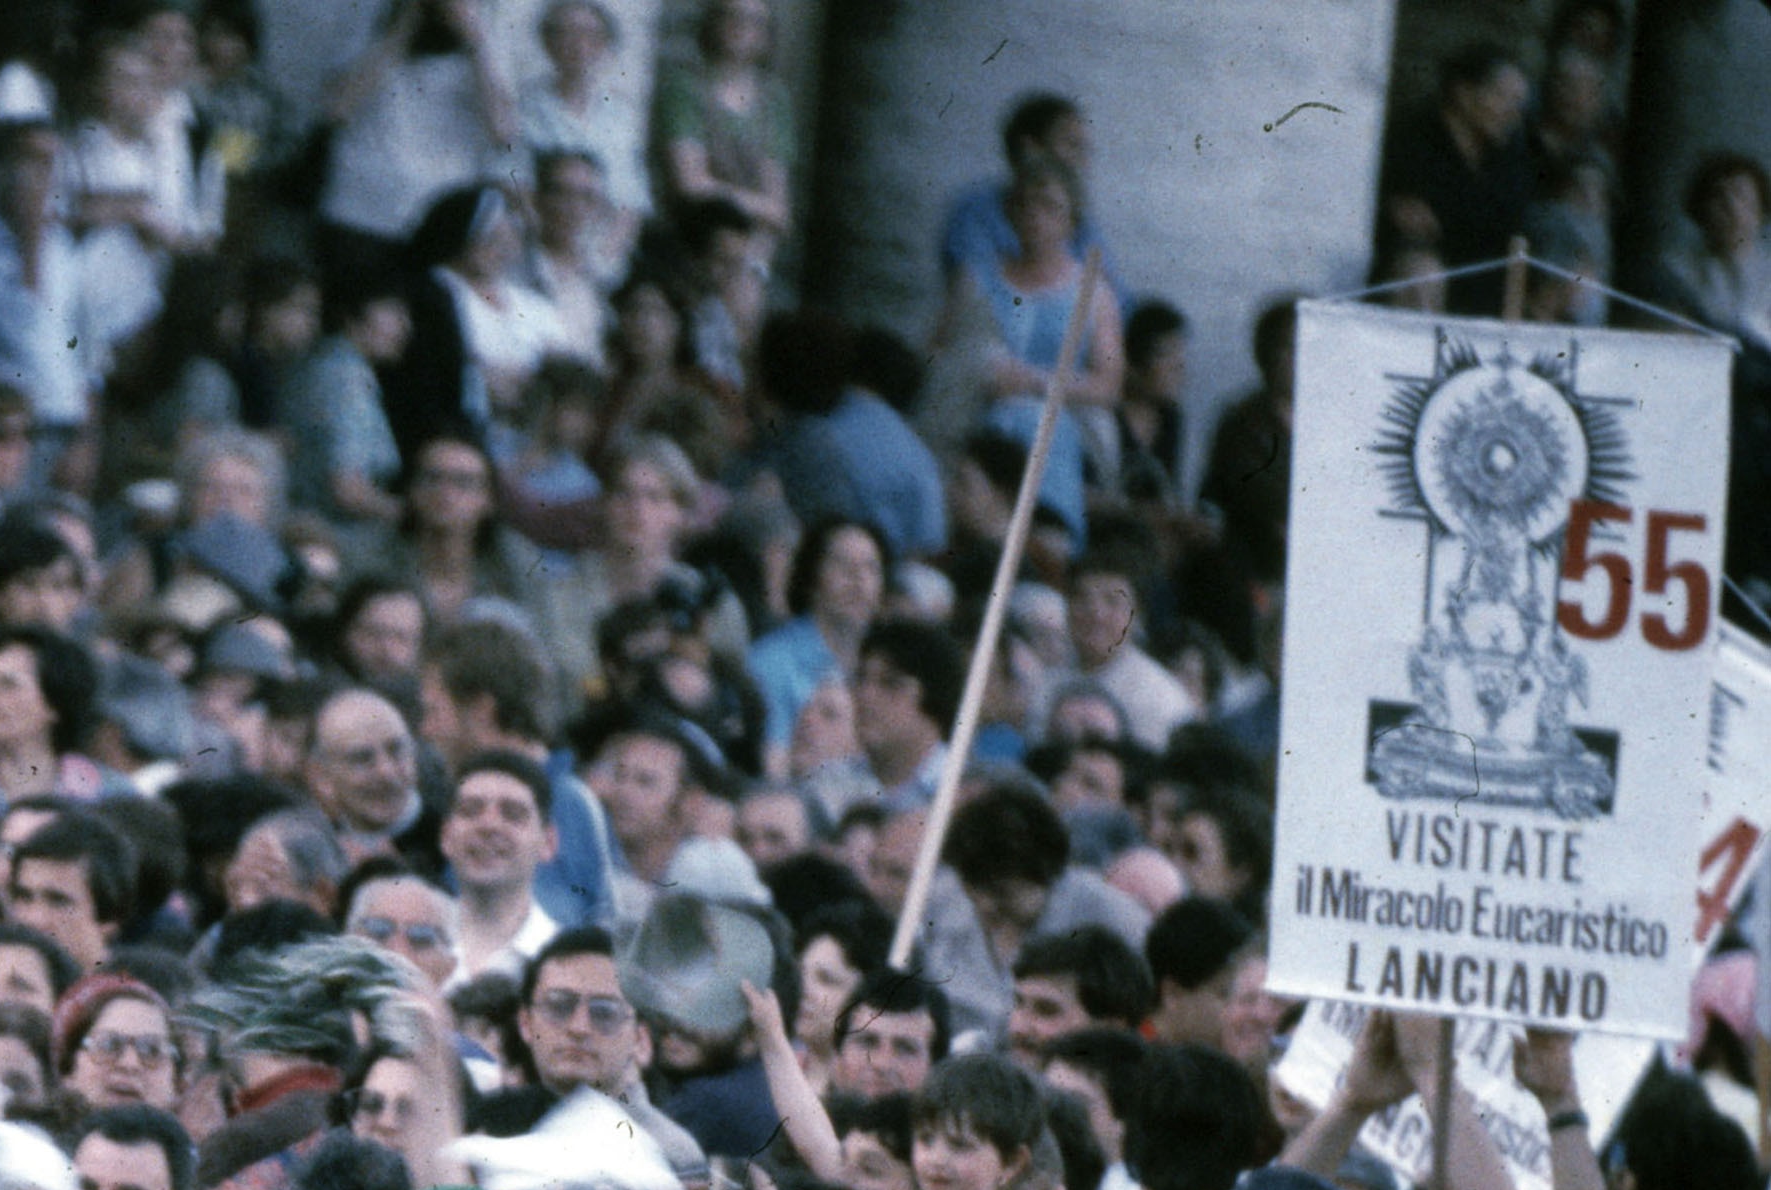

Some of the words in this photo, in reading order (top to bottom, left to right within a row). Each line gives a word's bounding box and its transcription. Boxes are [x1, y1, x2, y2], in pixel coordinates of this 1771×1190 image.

[1556, 498, 1711, 653] 55
[1387, 809, 1582, 883] VISITATE
[1296, 864, 1313, 914] il
[1320, 867, 1463, 934] Miracolo
[1471, 885, 1668, 958] Eucaristico
[1346, 941, 1607, 1021] LANCIANO
